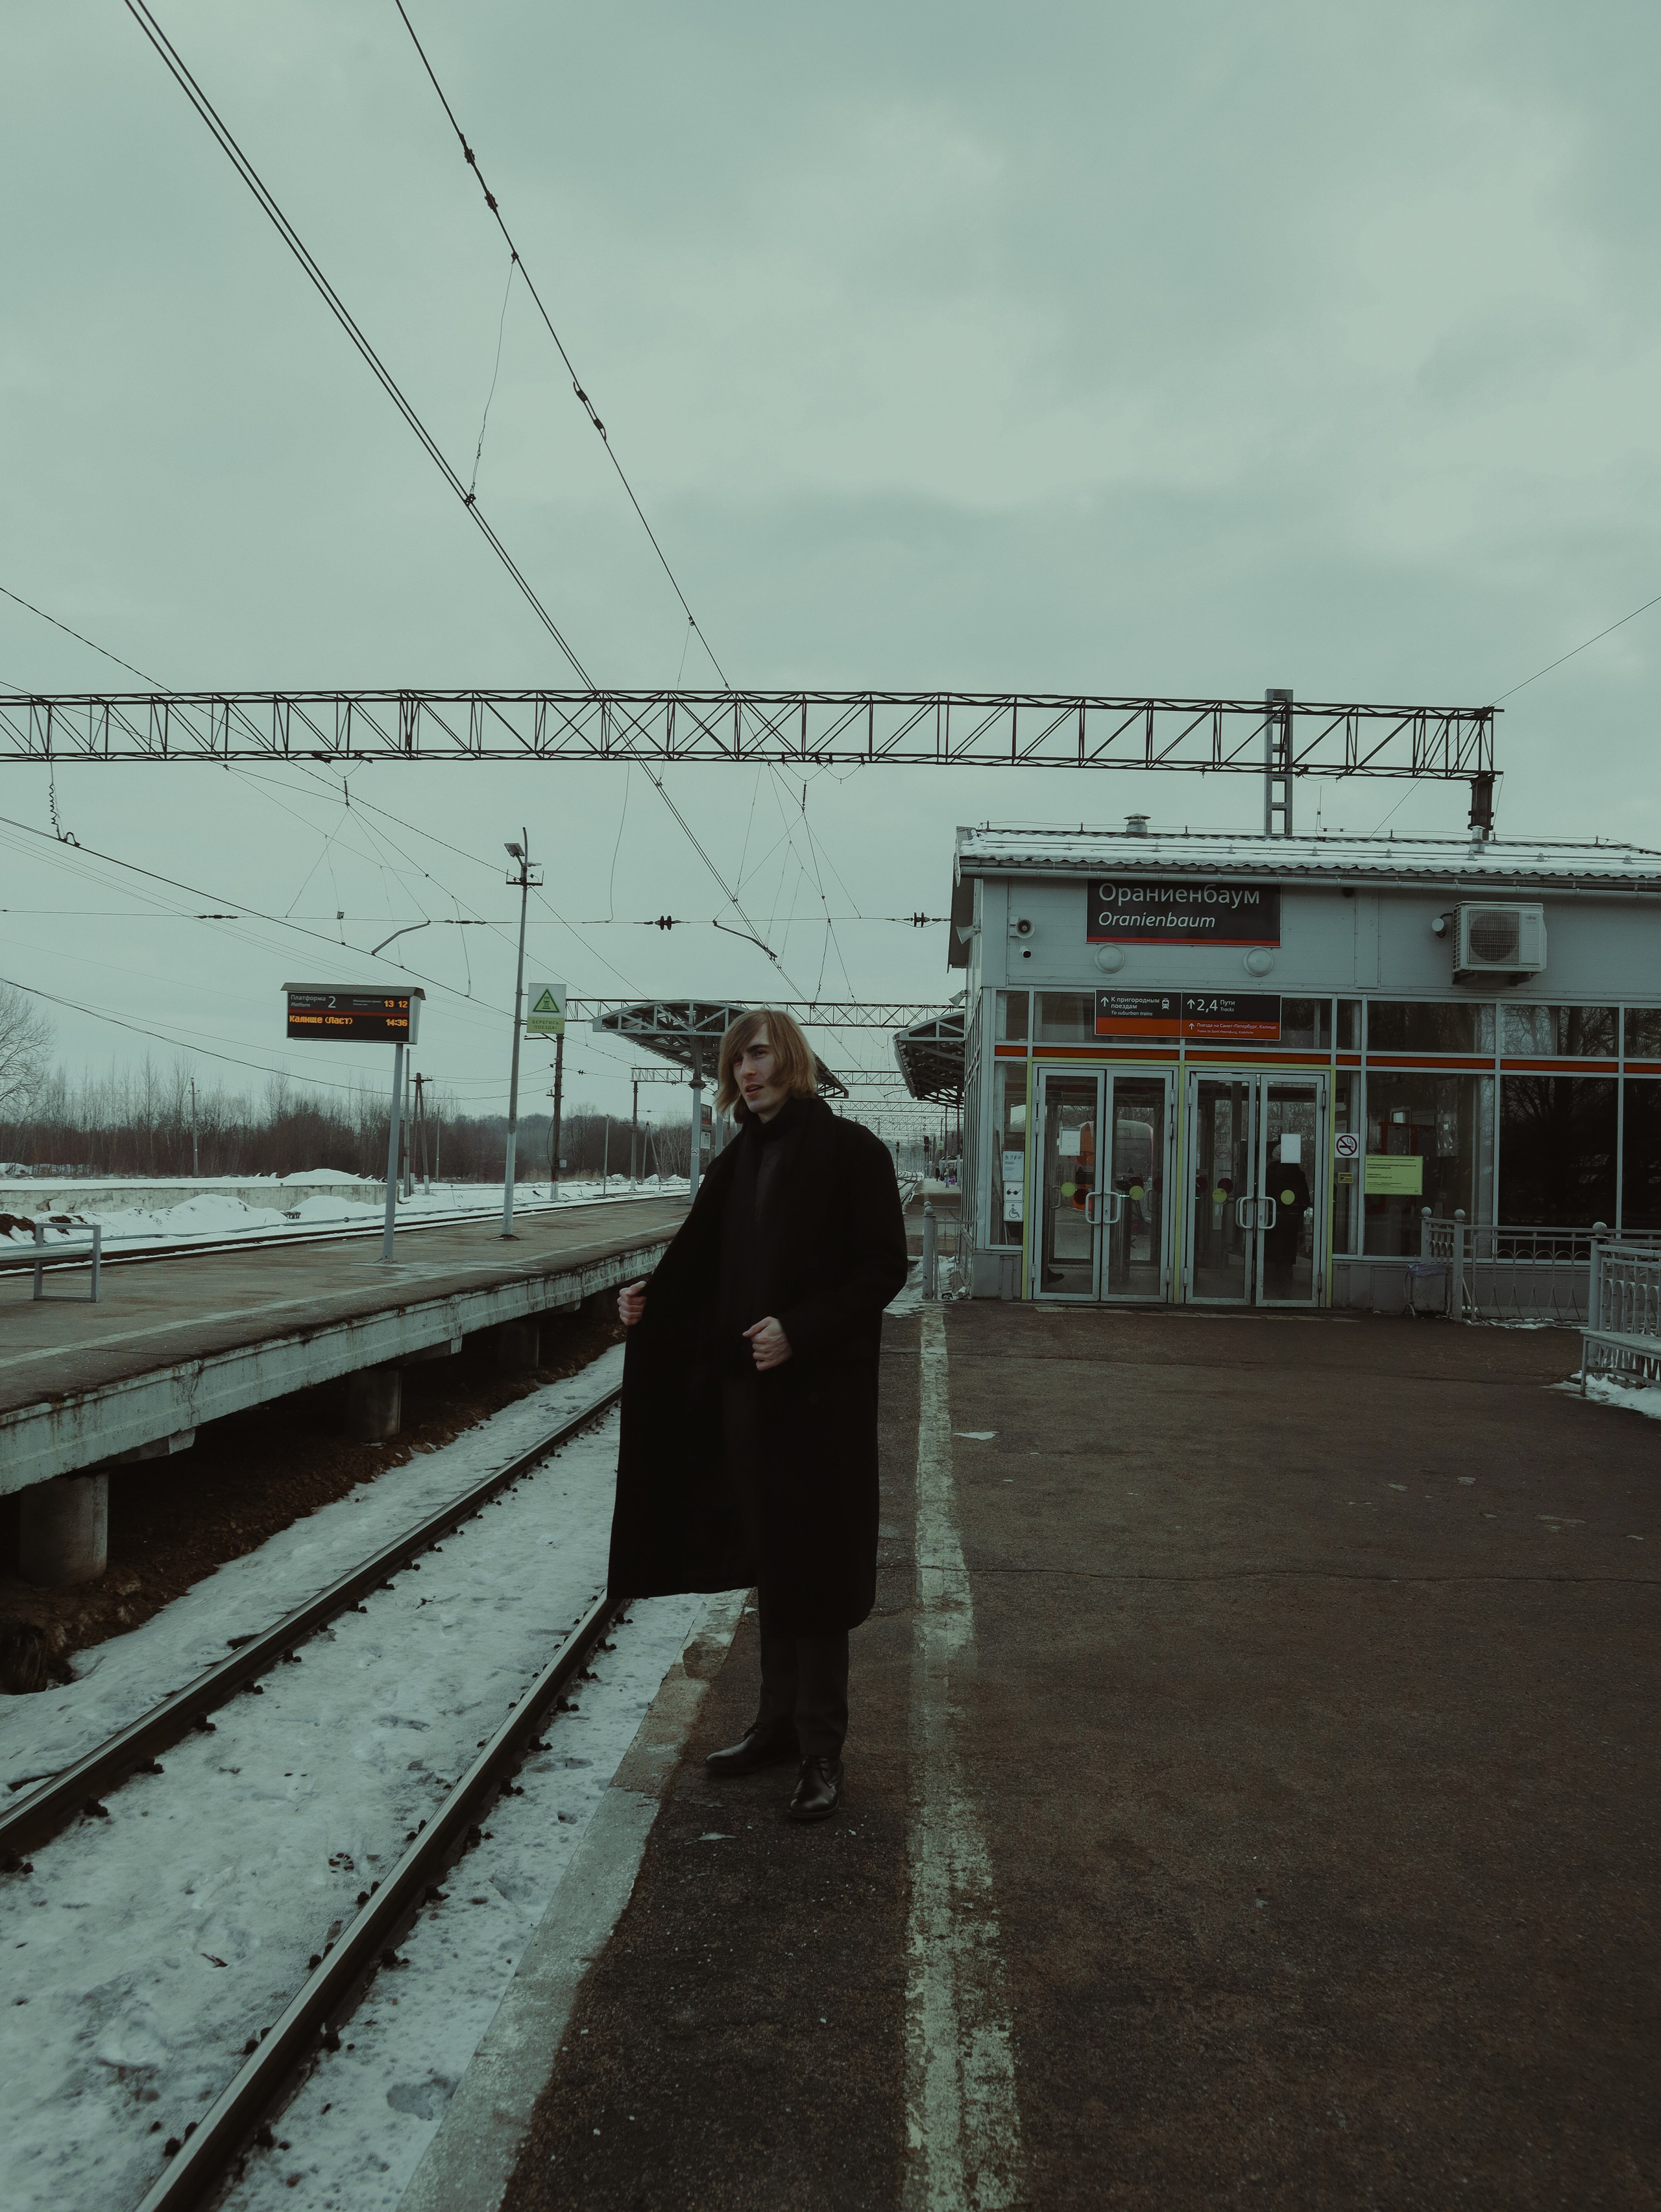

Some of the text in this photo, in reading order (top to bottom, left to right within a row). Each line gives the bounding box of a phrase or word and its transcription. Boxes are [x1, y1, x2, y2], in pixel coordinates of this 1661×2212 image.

[1098, 883, 1259, 909] Ораниенбаум
[1098, 912, 1215, 928] Oranienbaum
[328, 996, 336, 1008] 2
[1196, 999, 1218, 1013] 2,4
[325, 1016, 353, 1025] (Ласт)
